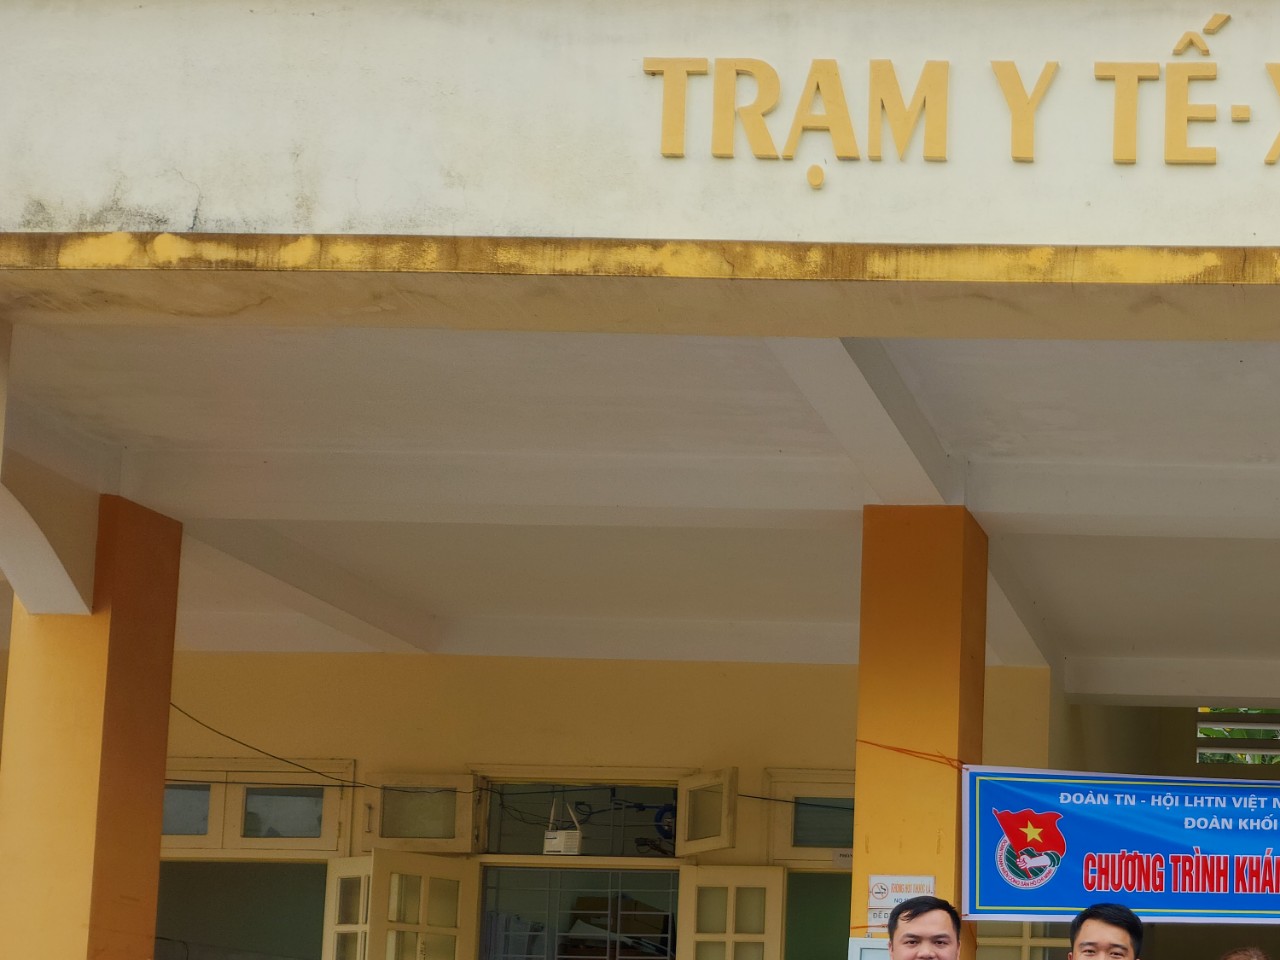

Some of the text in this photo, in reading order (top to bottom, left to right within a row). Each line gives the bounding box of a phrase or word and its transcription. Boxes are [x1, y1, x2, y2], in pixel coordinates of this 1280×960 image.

[643, 57, 950, 190] TRẠM
[990, 60, 1060, 162] Y
[1059, 790, 1109, 805] ĐOÀN
[1114, 793, 1136, 806] TN
[1150, 792, 1179, 810] HỘI
[1184, 795, 1227, 808] LHTN
[1232, 794, 1268, 811] VIỆT
[1184, 815, 1233, 830] ĐOÀN
[1238, 813, 1278, 831] KHỐI
[1083, 849, 1165, 892] CHƯƠNG
[1169, 846, 1229, 893] TRÌNH
